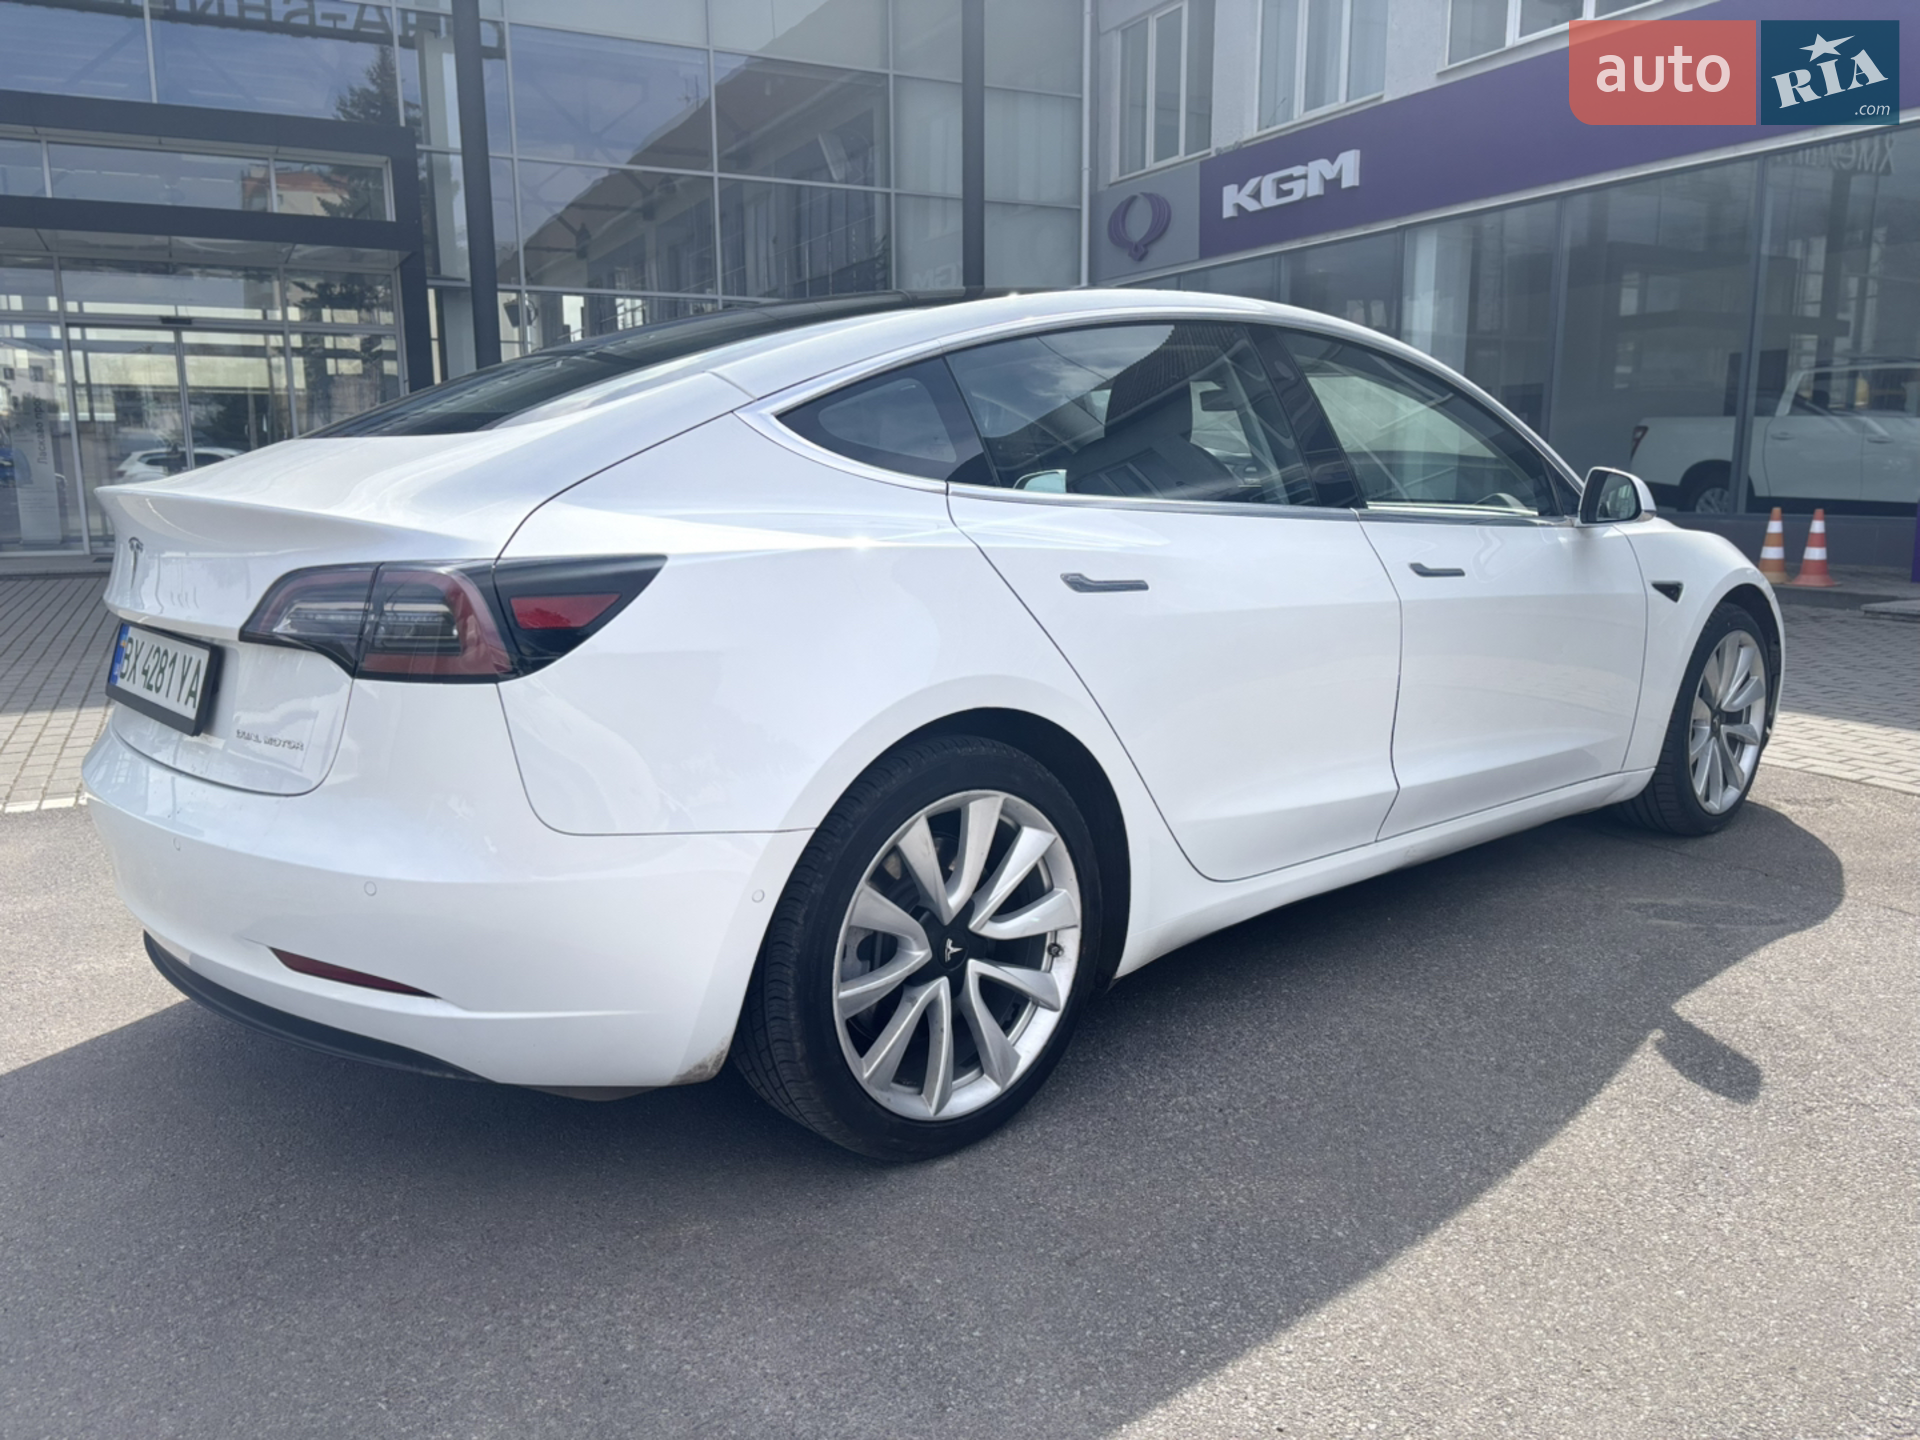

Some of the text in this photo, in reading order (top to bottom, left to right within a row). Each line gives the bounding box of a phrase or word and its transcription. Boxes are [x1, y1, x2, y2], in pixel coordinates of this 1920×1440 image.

[1222, 149, 1361, 219] KGM
[119, 636, 202, 709] BX 4281 YA
[262, 736, 305, 752] MOTOR
